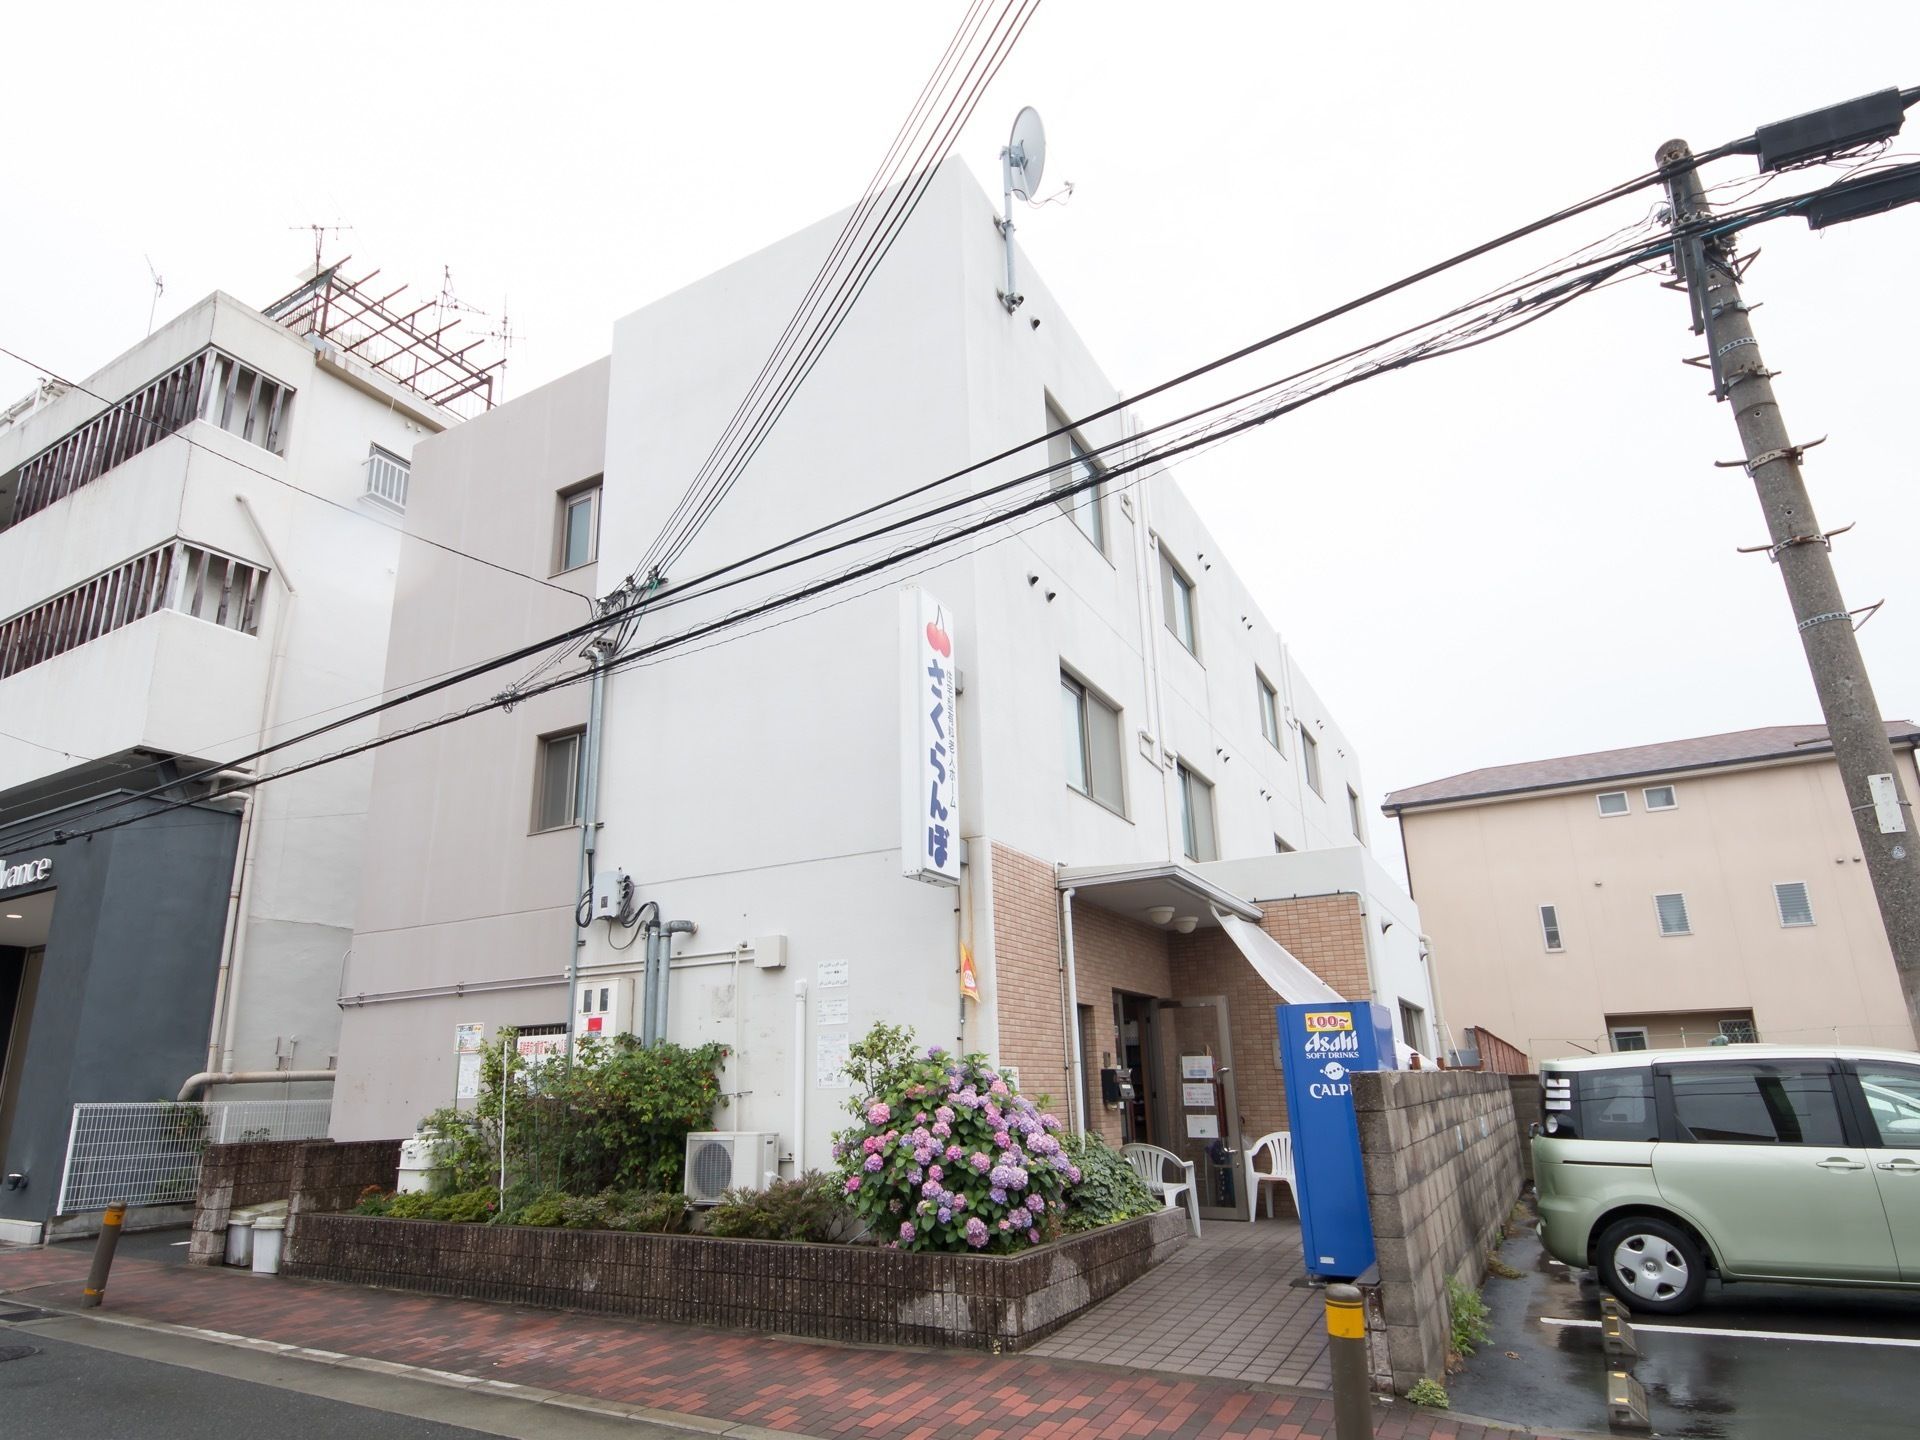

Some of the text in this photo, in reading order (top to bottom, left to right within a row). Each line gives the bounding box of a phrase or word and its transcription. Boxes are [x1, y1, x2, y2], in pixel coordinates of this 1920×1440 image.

[927, 658, 949, 868] さくらんぼ
[0, 858, 52, 889] vance
[1304, 1030, 1358, 1052] Asahi
